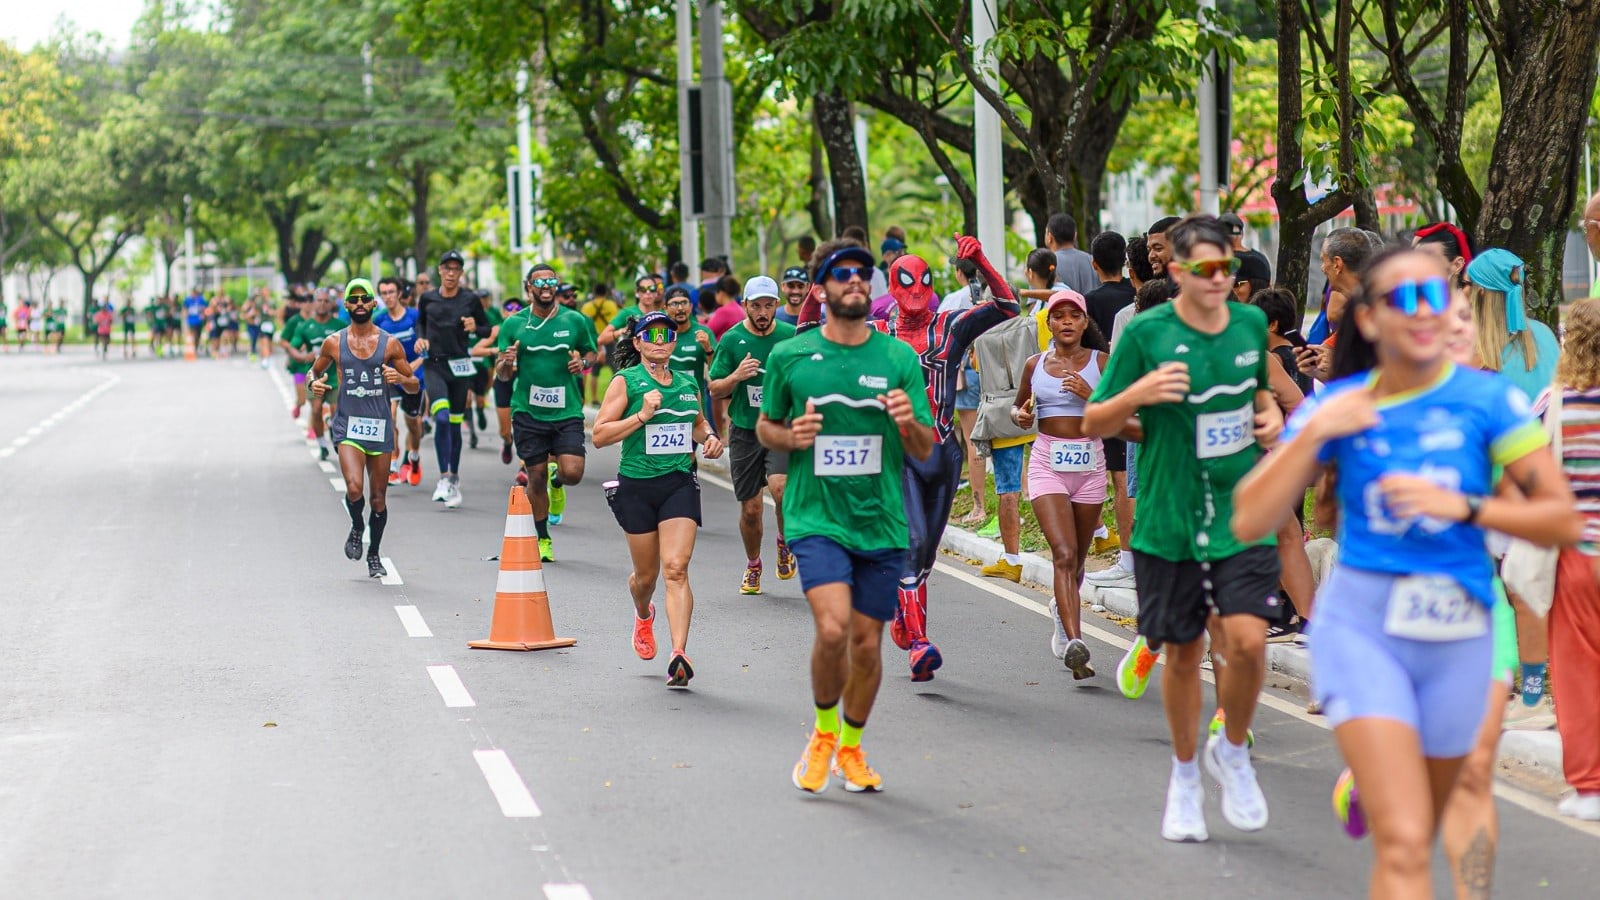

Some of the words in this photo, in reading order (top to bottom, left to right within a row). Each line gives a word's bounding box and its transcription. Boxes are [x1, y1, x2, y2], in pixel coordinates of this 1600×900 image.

[533, 393, 559, 403] 4708
[351, 424, 378, 436] 4132
[651, 433, 685, 447] 2242
[823, 449, 869, 465] 5517
[1055, 451, 1090, 465] 3420
[1527, 676, 1542, 686] 42
[1525, 685, 1542, 694] KM
